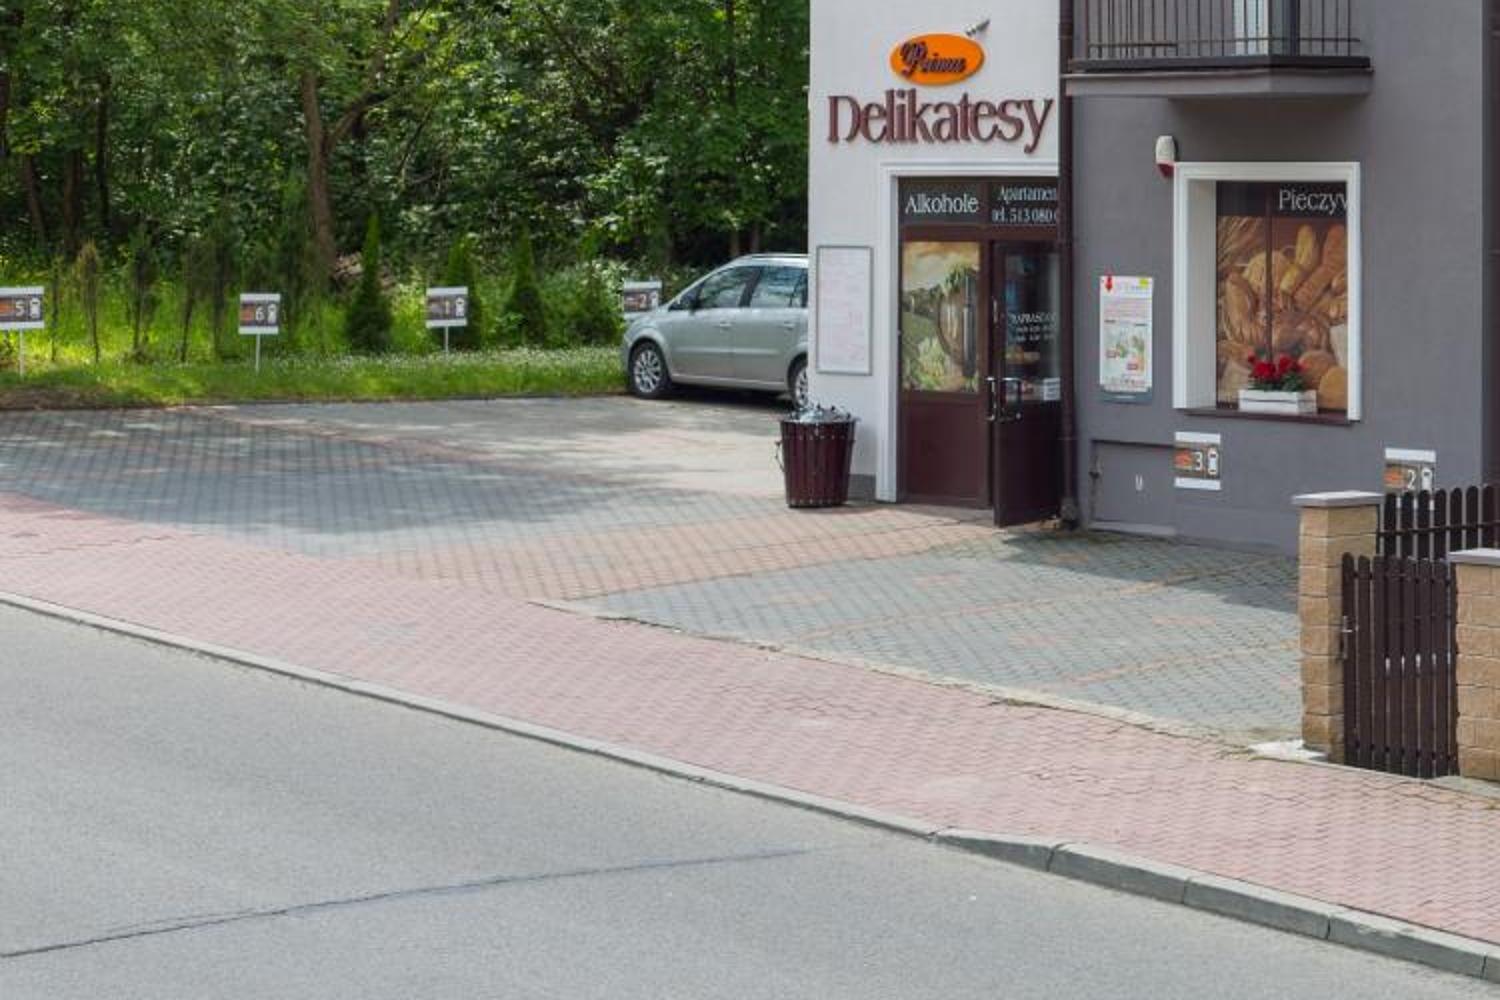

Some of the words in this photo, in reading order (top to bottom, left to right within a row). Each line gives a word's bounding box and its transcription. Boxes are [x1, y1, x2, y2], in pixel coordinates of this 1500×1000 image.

[827, 88, 1054, 154] Delikatesy
[904, 193, 979, 214] Alkohole
[15, 300, 25, 317] 5
[255, 306, 265, 322] 6
[1194, 451, 1203, 471] 3
[1407, 469, 1417, 490] 2
